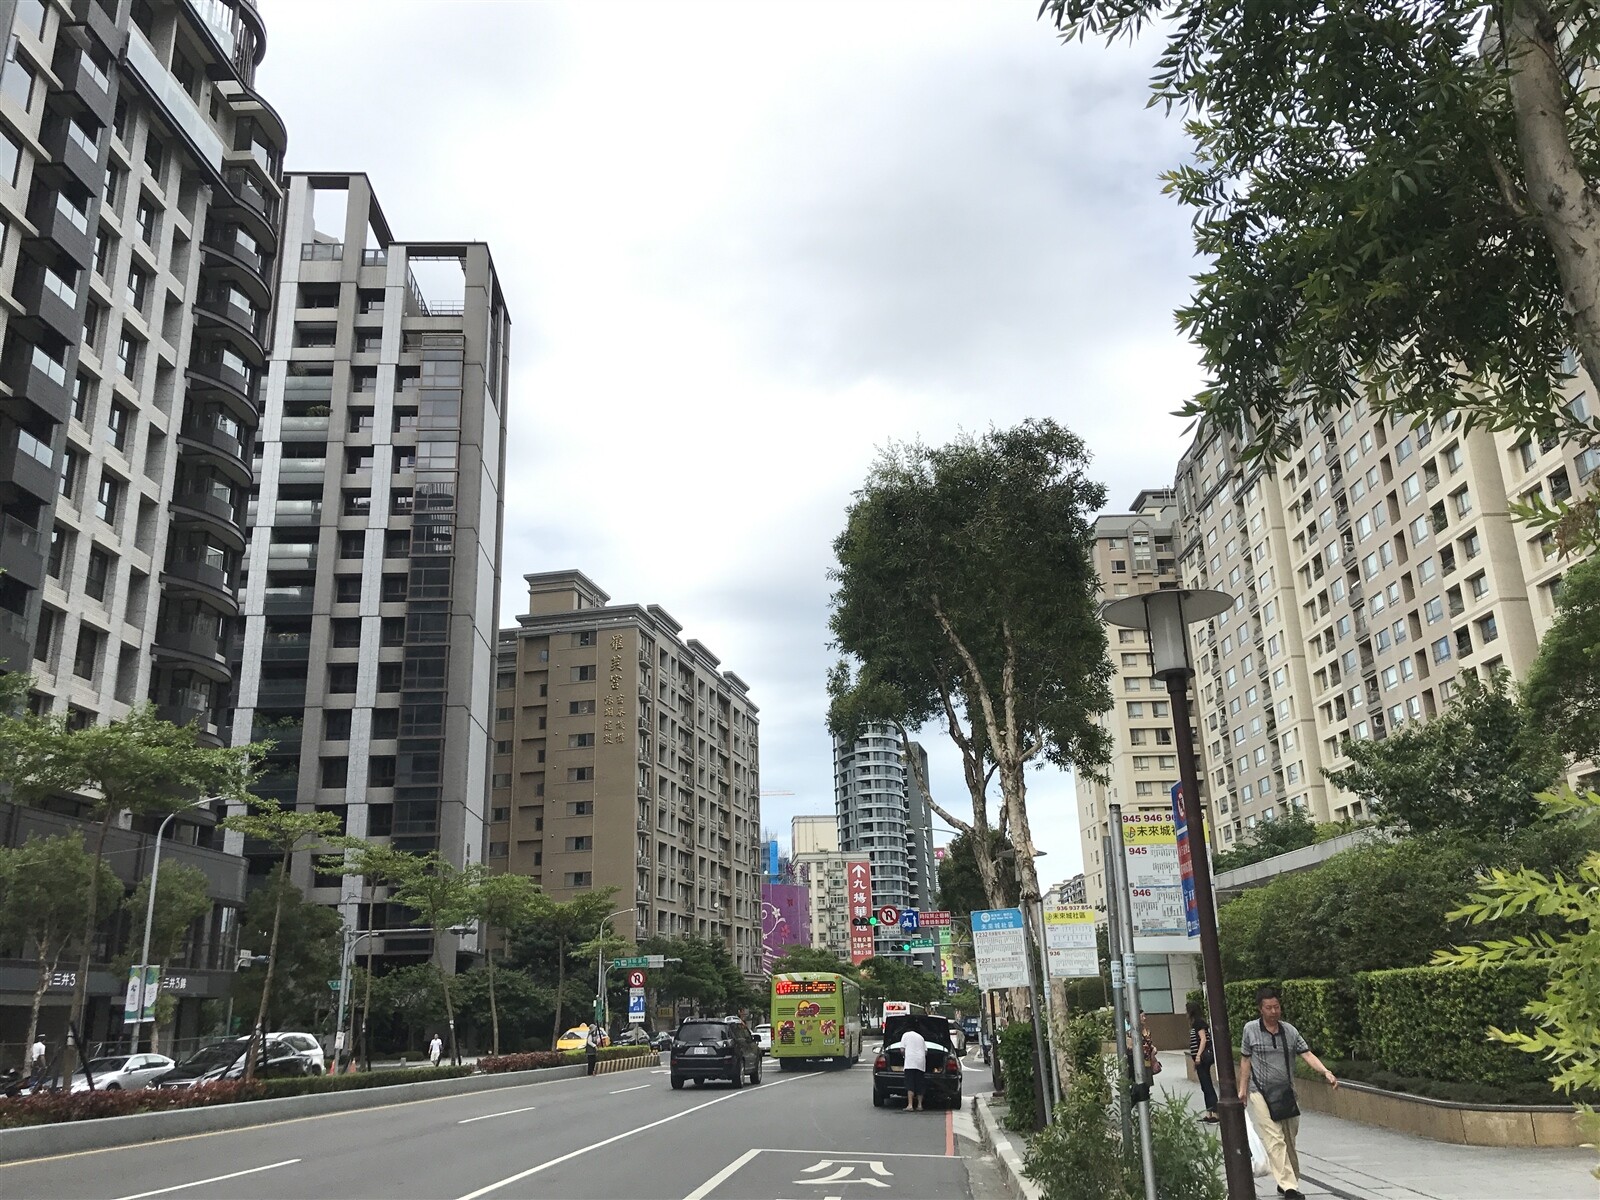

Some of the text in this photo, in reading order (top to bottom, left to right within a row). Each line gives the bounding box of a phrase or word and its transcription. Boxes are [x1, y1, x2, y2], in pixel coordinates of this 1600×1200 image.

[1122, 814, 1142, 823] 945
[1144, 813, 1163, 822] 946
[1128, 847, 1148, 856] 945
[1132, 889, 1151, 897] 946
[1053, 912, 1086, 920] 未來城社區
[49, 973, 76, 987] 三井3
[630, 996, 639, 1007] P
[792, 1159, 894, 1188] 公
